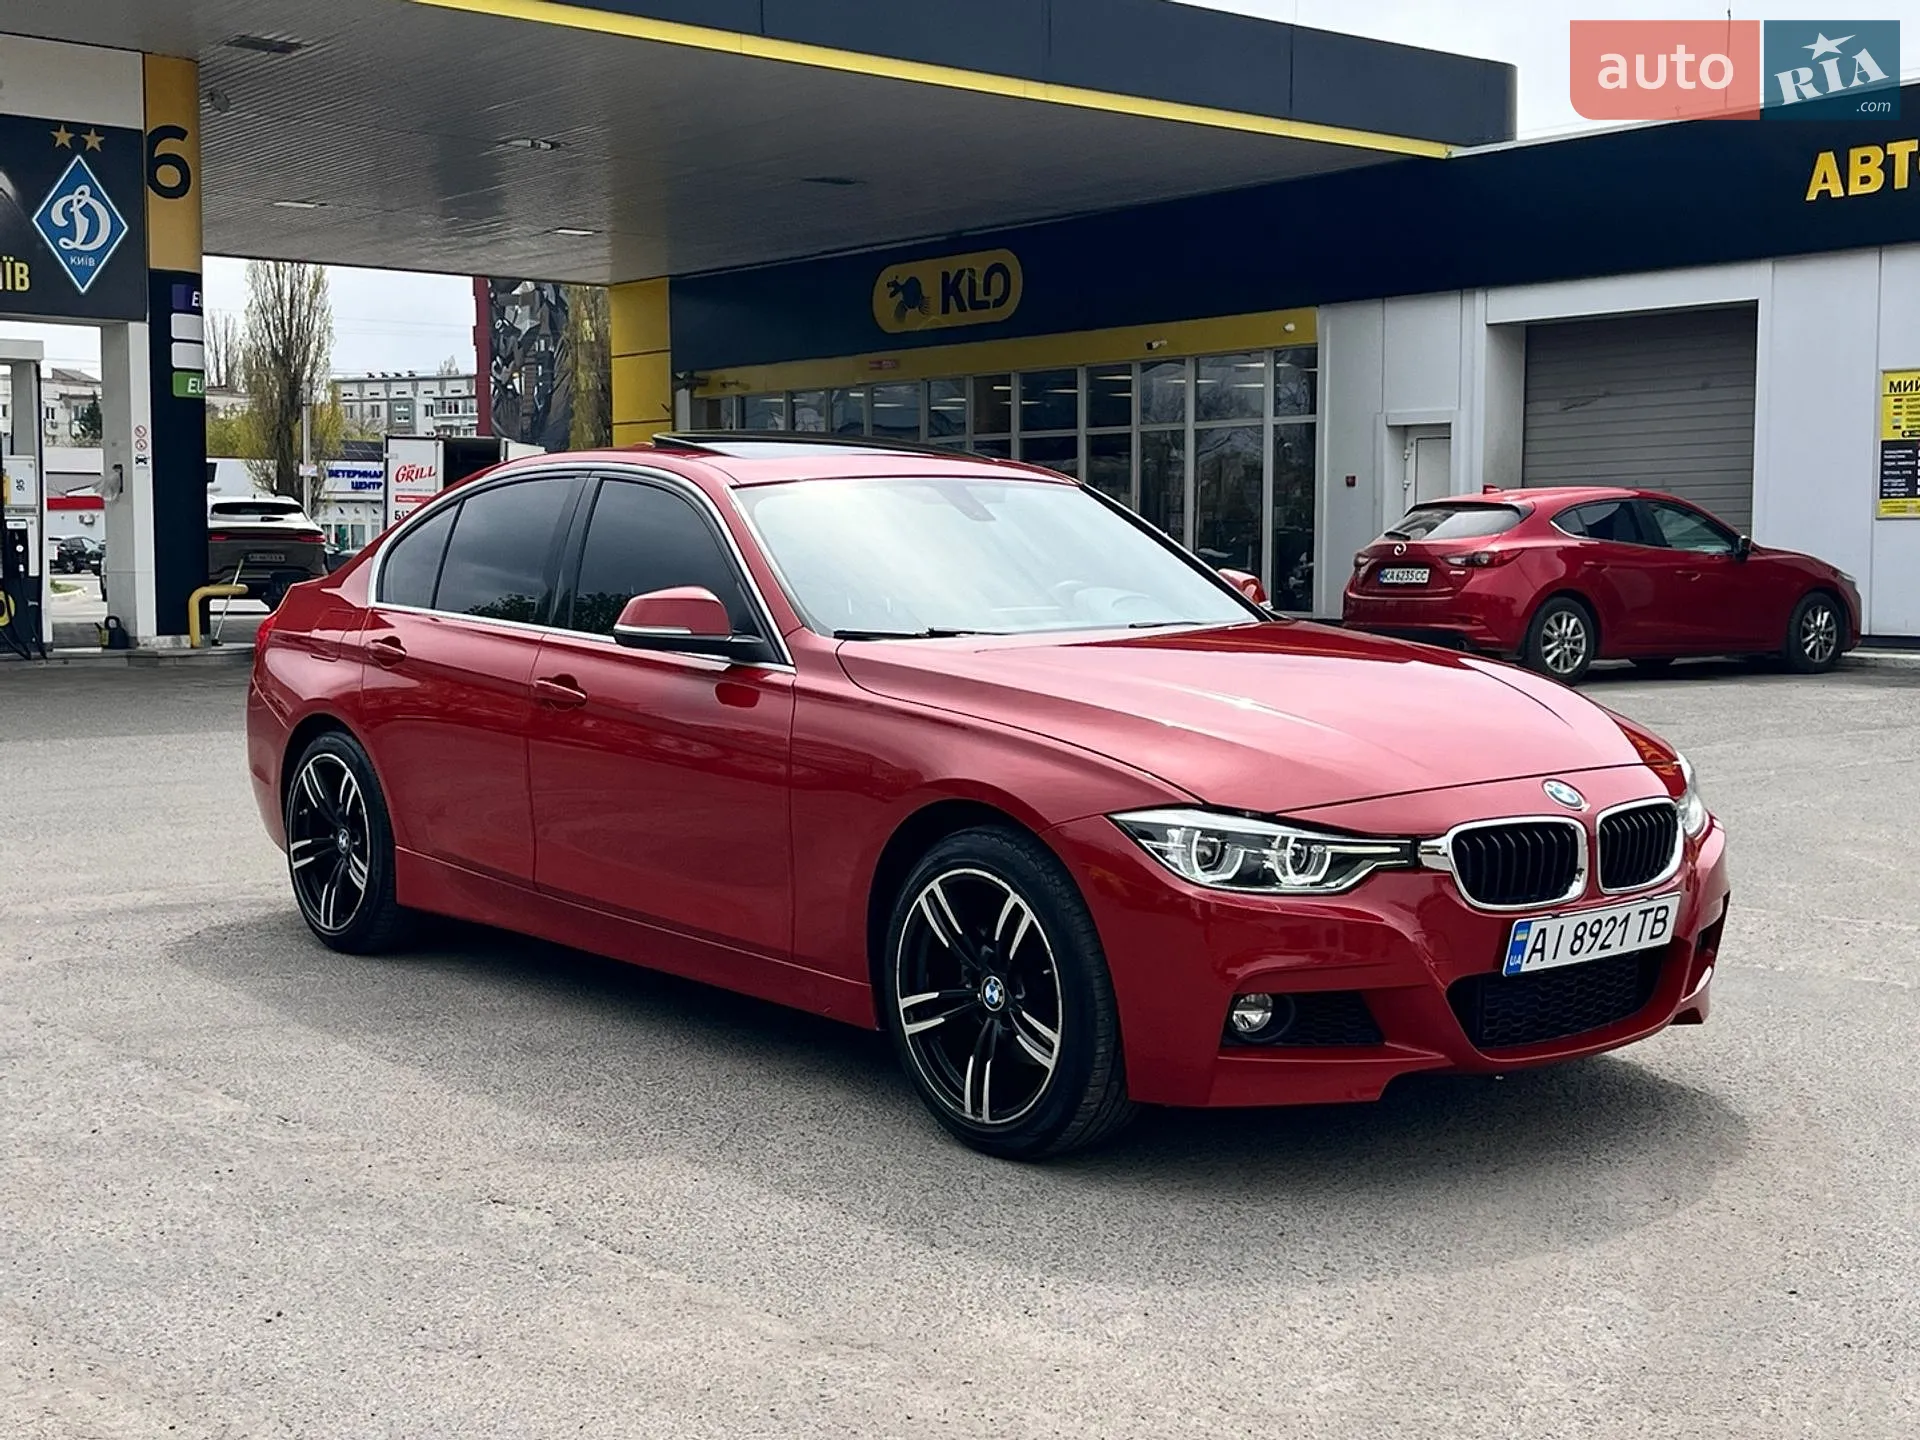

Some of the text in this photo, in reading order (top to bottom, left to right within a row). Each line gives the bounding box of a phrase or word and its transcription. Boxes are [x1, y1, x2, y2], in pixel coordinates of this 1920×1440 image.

[147, 124, 191, 199] 6
[1805, 138, 1920, 201] АВТ
[0, 256, 30, 291] ЇВ
[70, 255, 96, 267] КИЇВ
[941, 262, 1011, 315] KLO
[1570, 912, 1632, 956] 8921
[1637, 905, 1670, 943] TB
